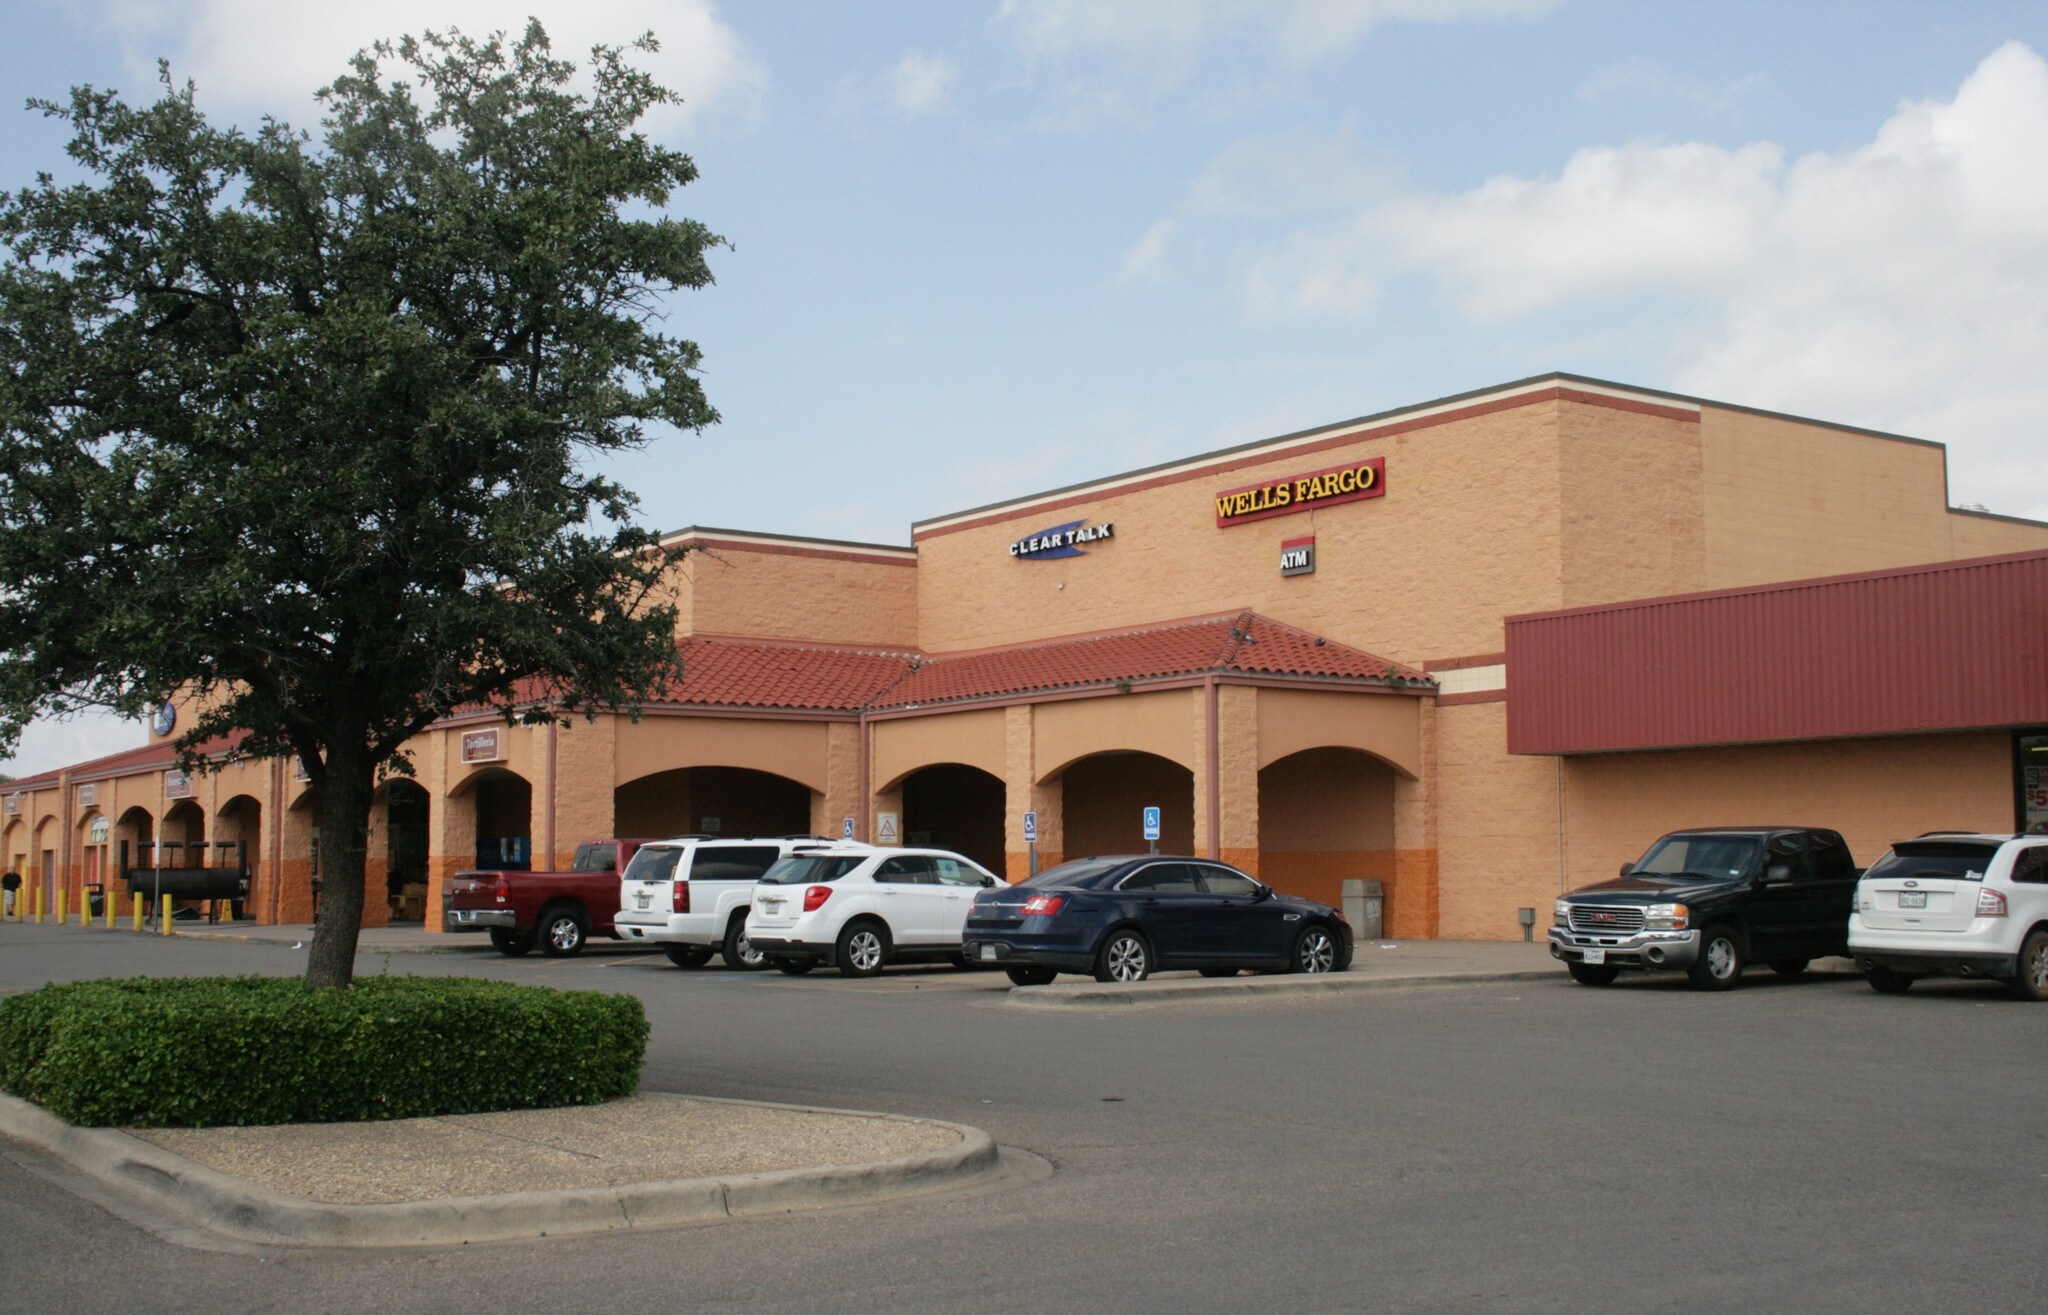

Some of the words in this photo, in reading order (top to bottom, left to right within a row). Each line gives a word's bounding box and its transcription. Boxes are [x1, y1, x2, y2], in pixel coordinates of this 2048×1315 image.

[1215, 483, 1291, 518] WELLS
[1294, 466, 1375, 502] FARGO
[1008, 534, 1062, 556] CLEAR
[1065, 523, 1111, 544] TALK
[1280, 550, 1307, 570] ATM
[466, 736, 494, 749] Tortilleria
